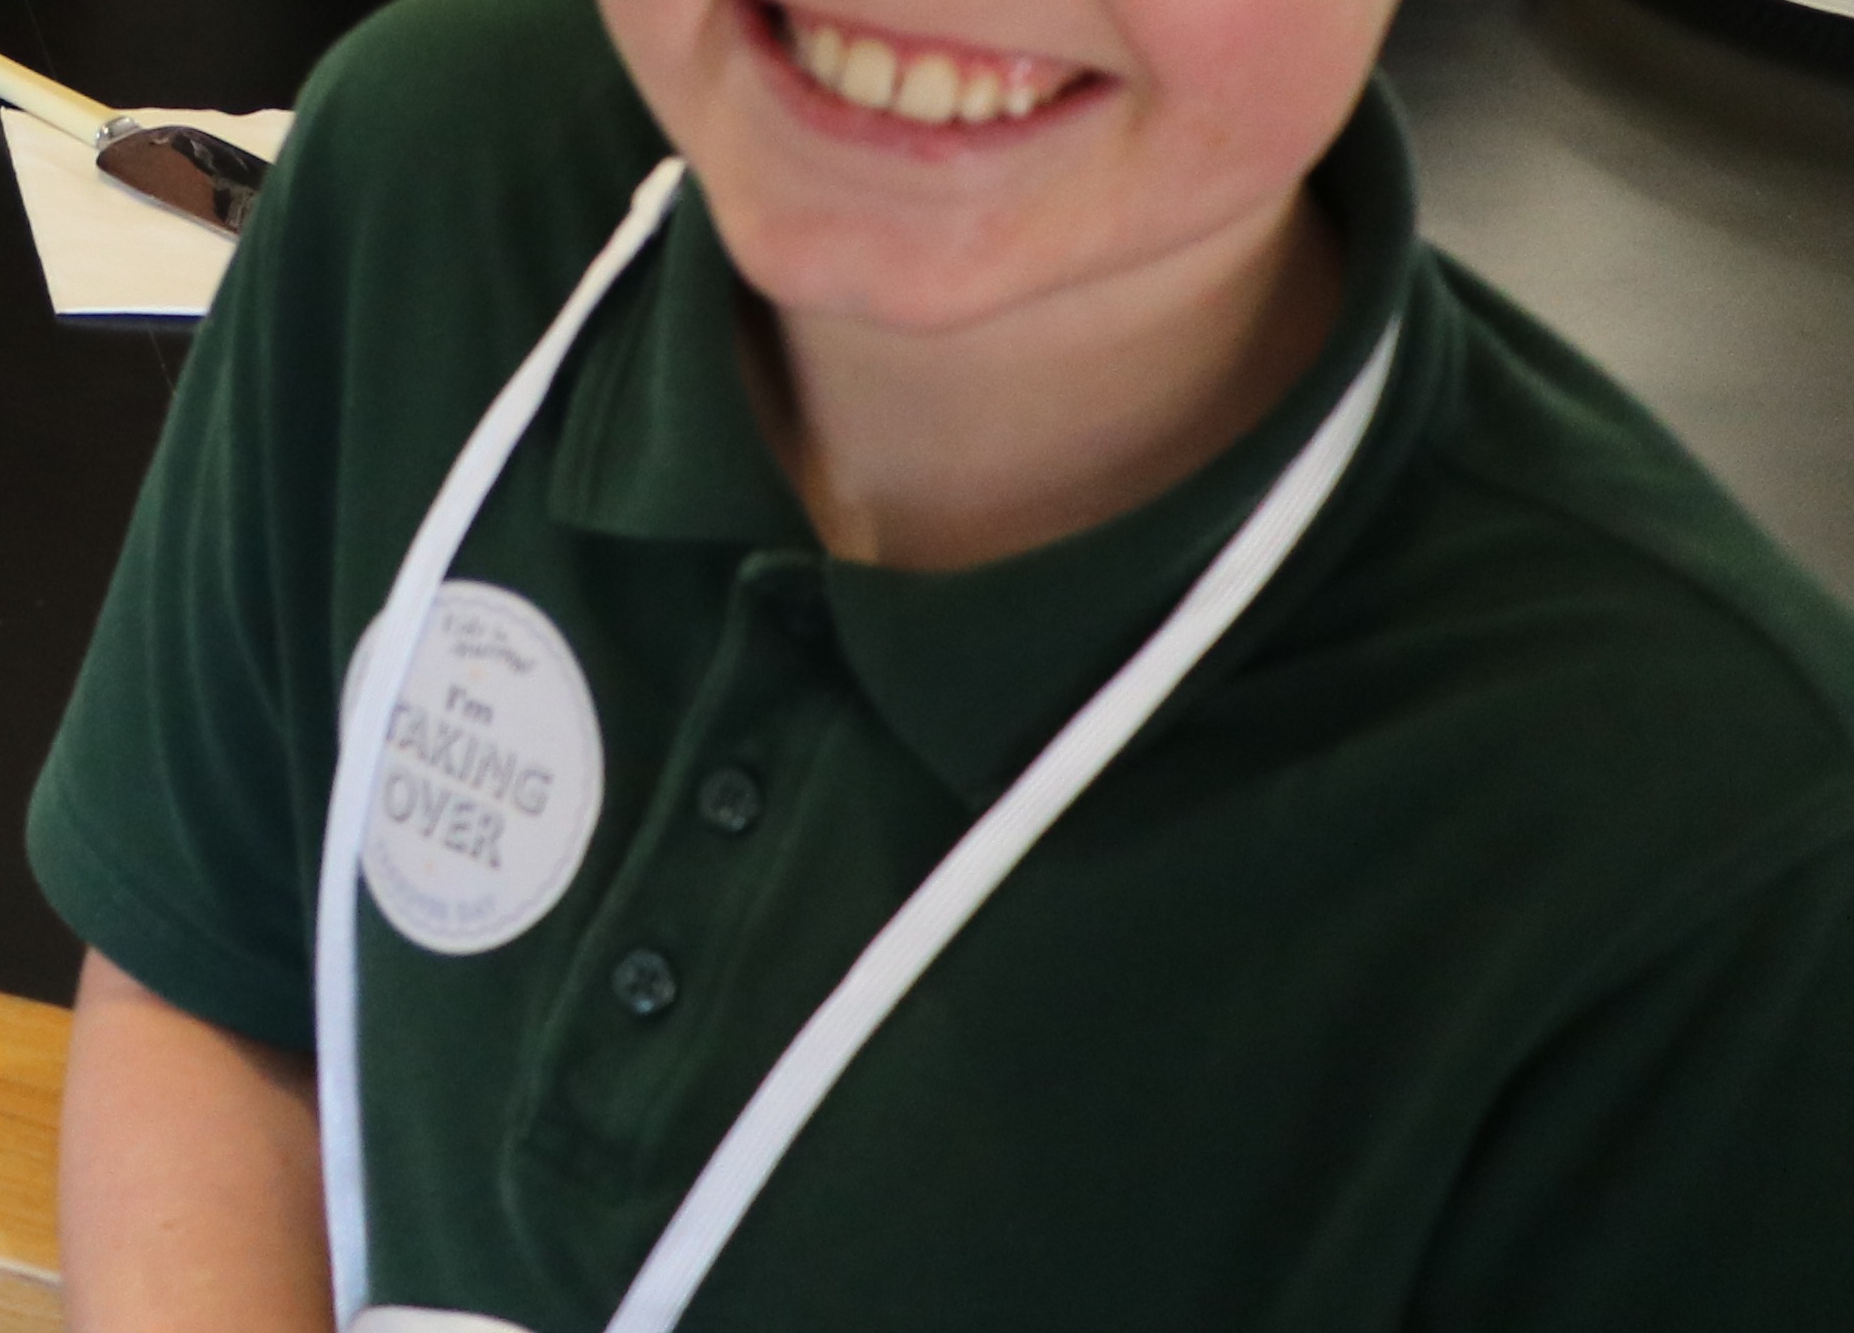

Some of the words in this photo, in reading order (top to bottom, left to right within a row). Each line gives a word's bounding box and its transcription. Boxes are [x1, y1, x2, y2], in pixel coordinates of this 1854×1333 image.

[446, 685, 494, 724] I'm
[386, 702, 555, 816] TAKING
[383, 772, 507, 870] OVER
